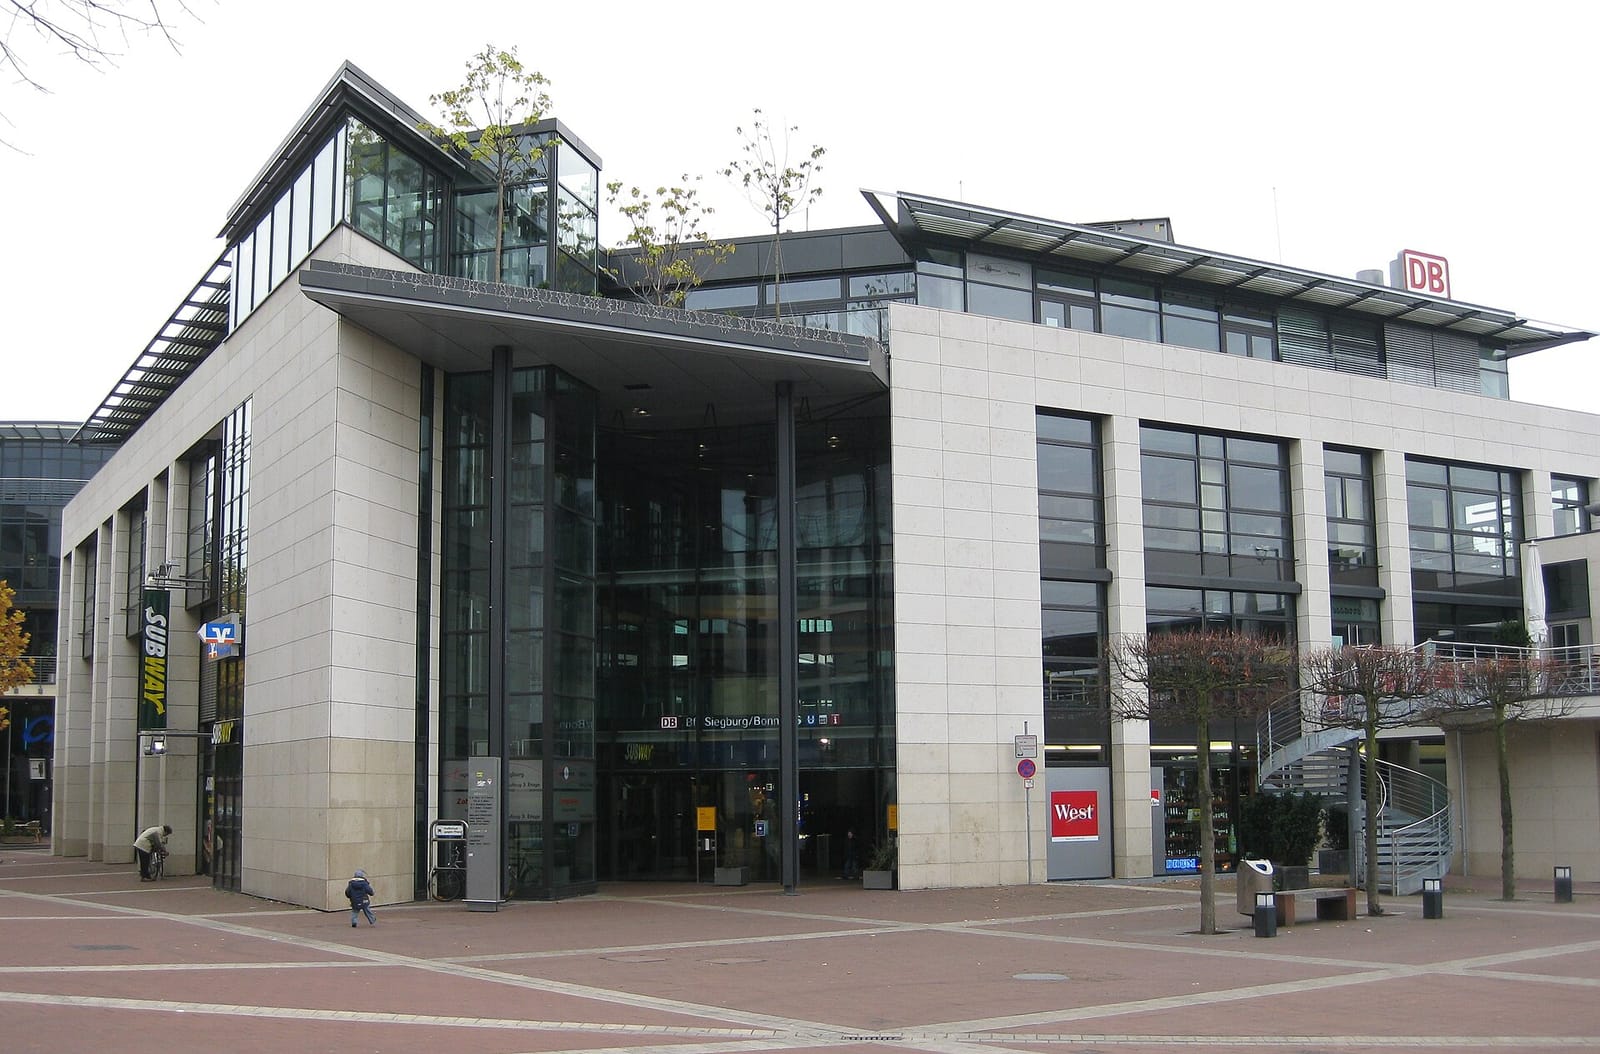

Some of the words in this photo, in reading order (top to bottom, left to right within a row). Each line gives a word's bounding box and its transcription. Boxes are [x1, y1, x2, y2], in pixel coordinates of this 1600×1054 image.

[1409, 257, 1444, 293] DB
[144, 606, 167, 716] SUBWAY
[704, 716, 780, 729] Siegburg/Bonn
[625, 744, 653, 761] SUBWAY
[1055, 804, 1094, 822] West
